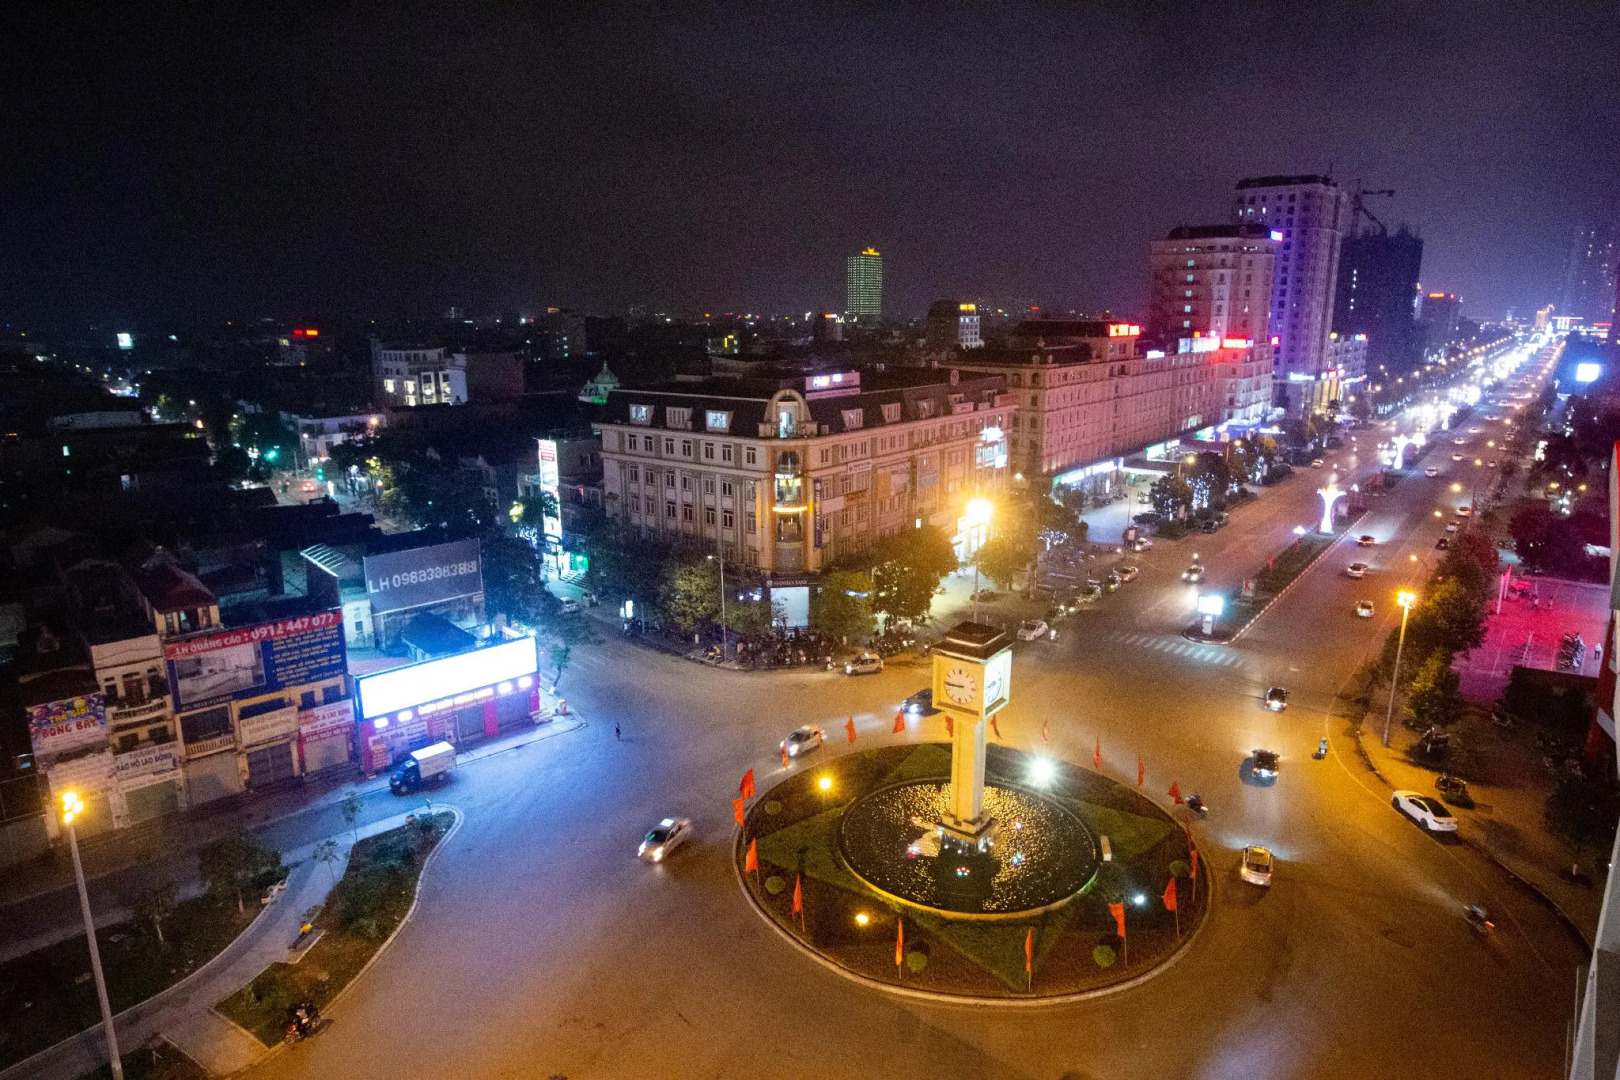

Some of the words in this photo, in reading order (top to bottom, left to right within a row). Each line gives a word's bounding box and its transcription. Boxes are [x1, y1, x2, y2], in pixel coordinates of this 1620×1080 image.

[368, 577, 391, 594] LH
[251, 623, 285, 641] 0912
[287, 617, 310, 633] 447
[311, 612, 335, 628] 077
